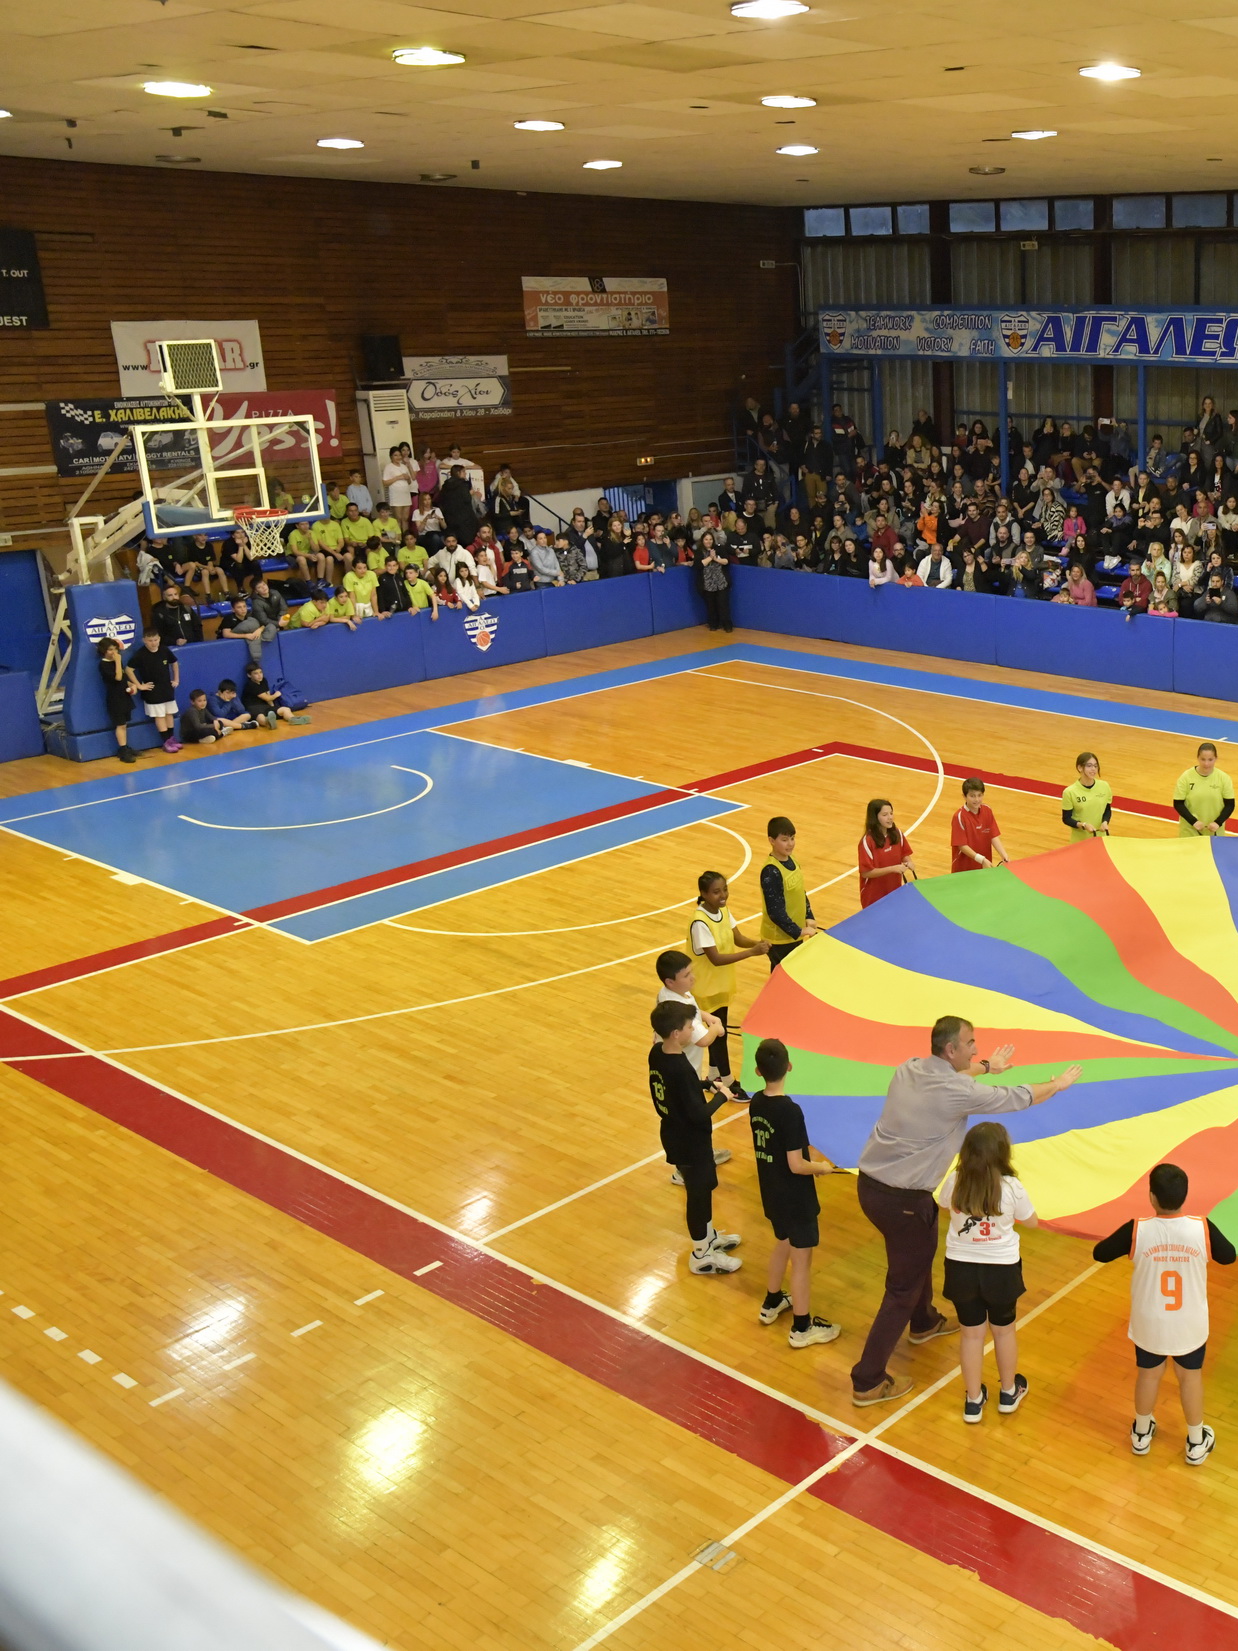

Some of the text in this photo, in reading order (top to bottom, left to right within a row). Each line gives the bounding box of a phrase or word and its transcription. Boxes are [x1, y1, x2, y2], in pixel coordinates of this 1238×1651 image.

[540, 291, 654, 306] νέο φροντιστήριο
[0, 316, 28, 326] EST
[865, 314, 992, 331] TEAMWORK COMPETITION
[851, 335, 996, 355] MOTIVATION VICTORY FAITH
[421, 381, 460, 402] Οδός
[162, 450, 195, 458] RENTALS
[91, 625, 133, 634] ΑΙΓΑΛΕΩ
[1161, 1270, 1182, 1311] 9
